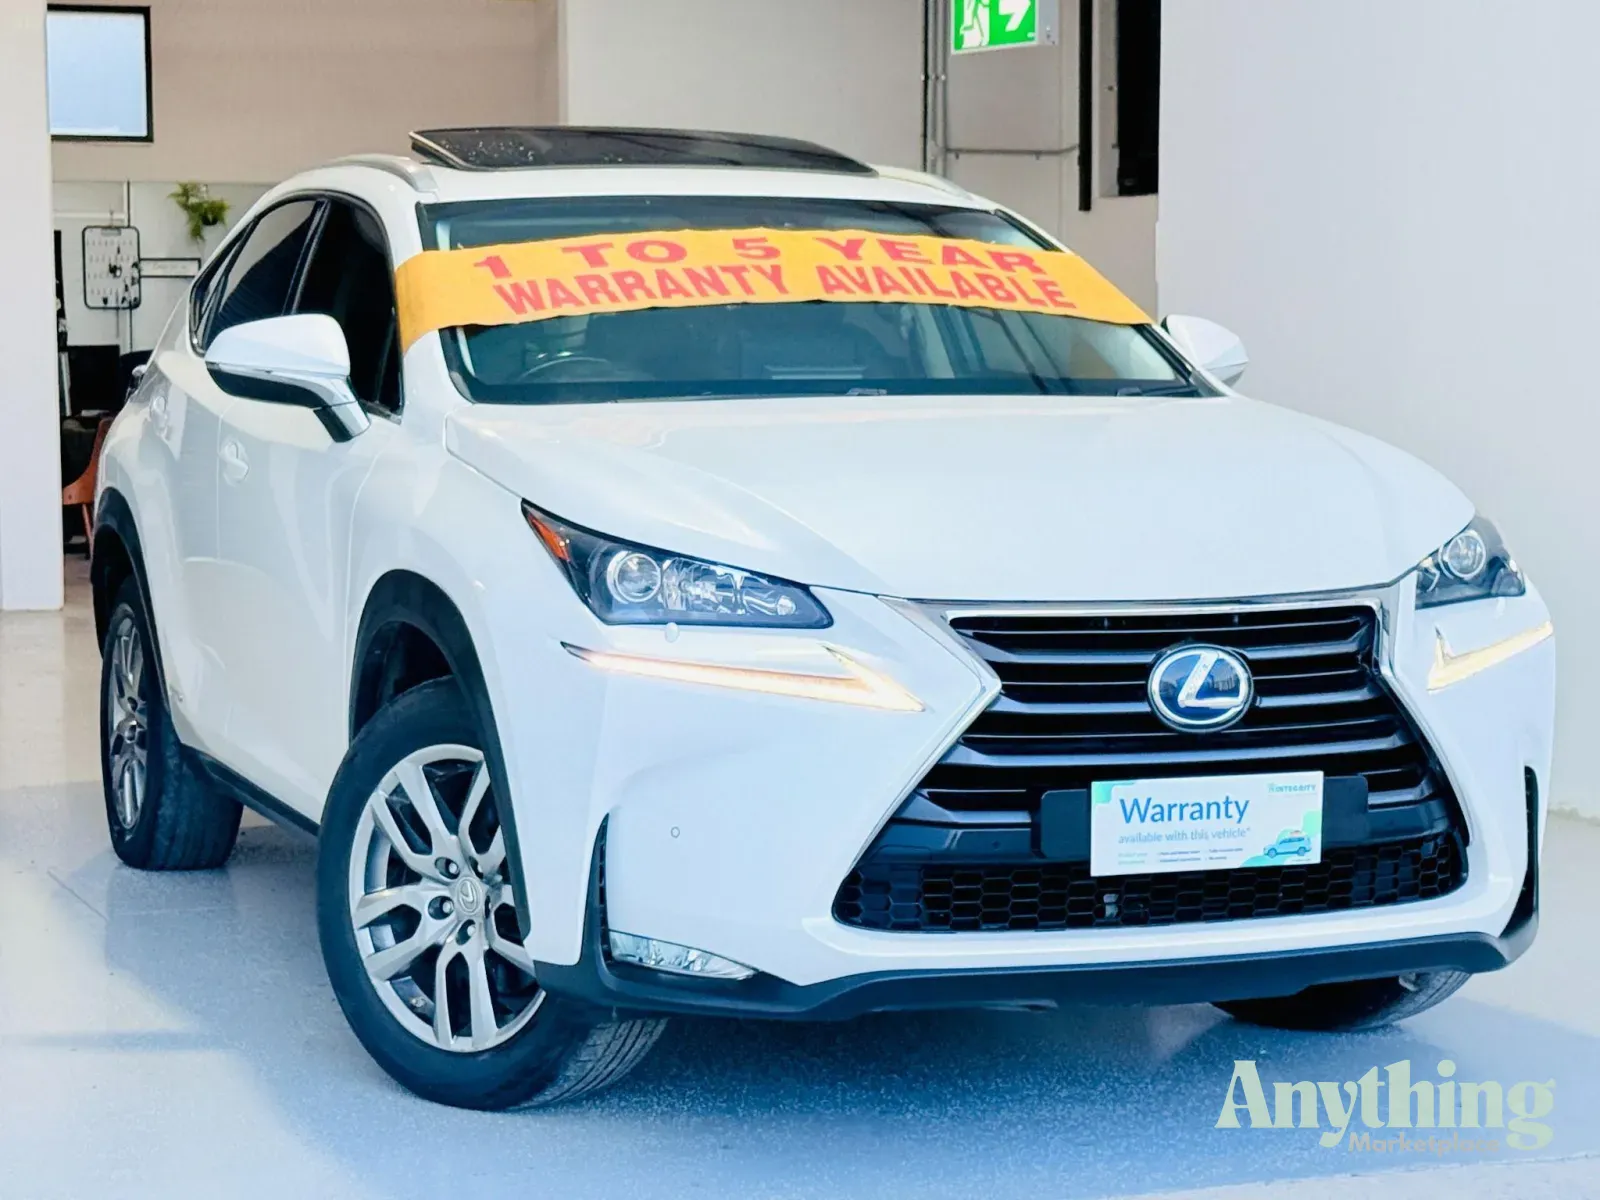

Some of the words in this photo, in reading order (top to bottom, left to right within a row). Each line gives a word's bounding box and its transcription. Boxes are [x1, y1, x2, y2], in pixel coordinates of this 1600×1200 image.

[473, 255, 512, 279] 1
[561, 239, 688, 269] TO
[732, 236, 781, 260] 5
[812, 236, 1047, 275] YEAR
[493, 263, 789, 316] WARRANTY
[815, 264, 1077, 309] AVAILABLE
[1119, 795, 1249, 824] Warranty
[1118, 831, 1162, 844] available
[1165, 829, 1188, 842] with
[1190, 828, 1209, 841] this
